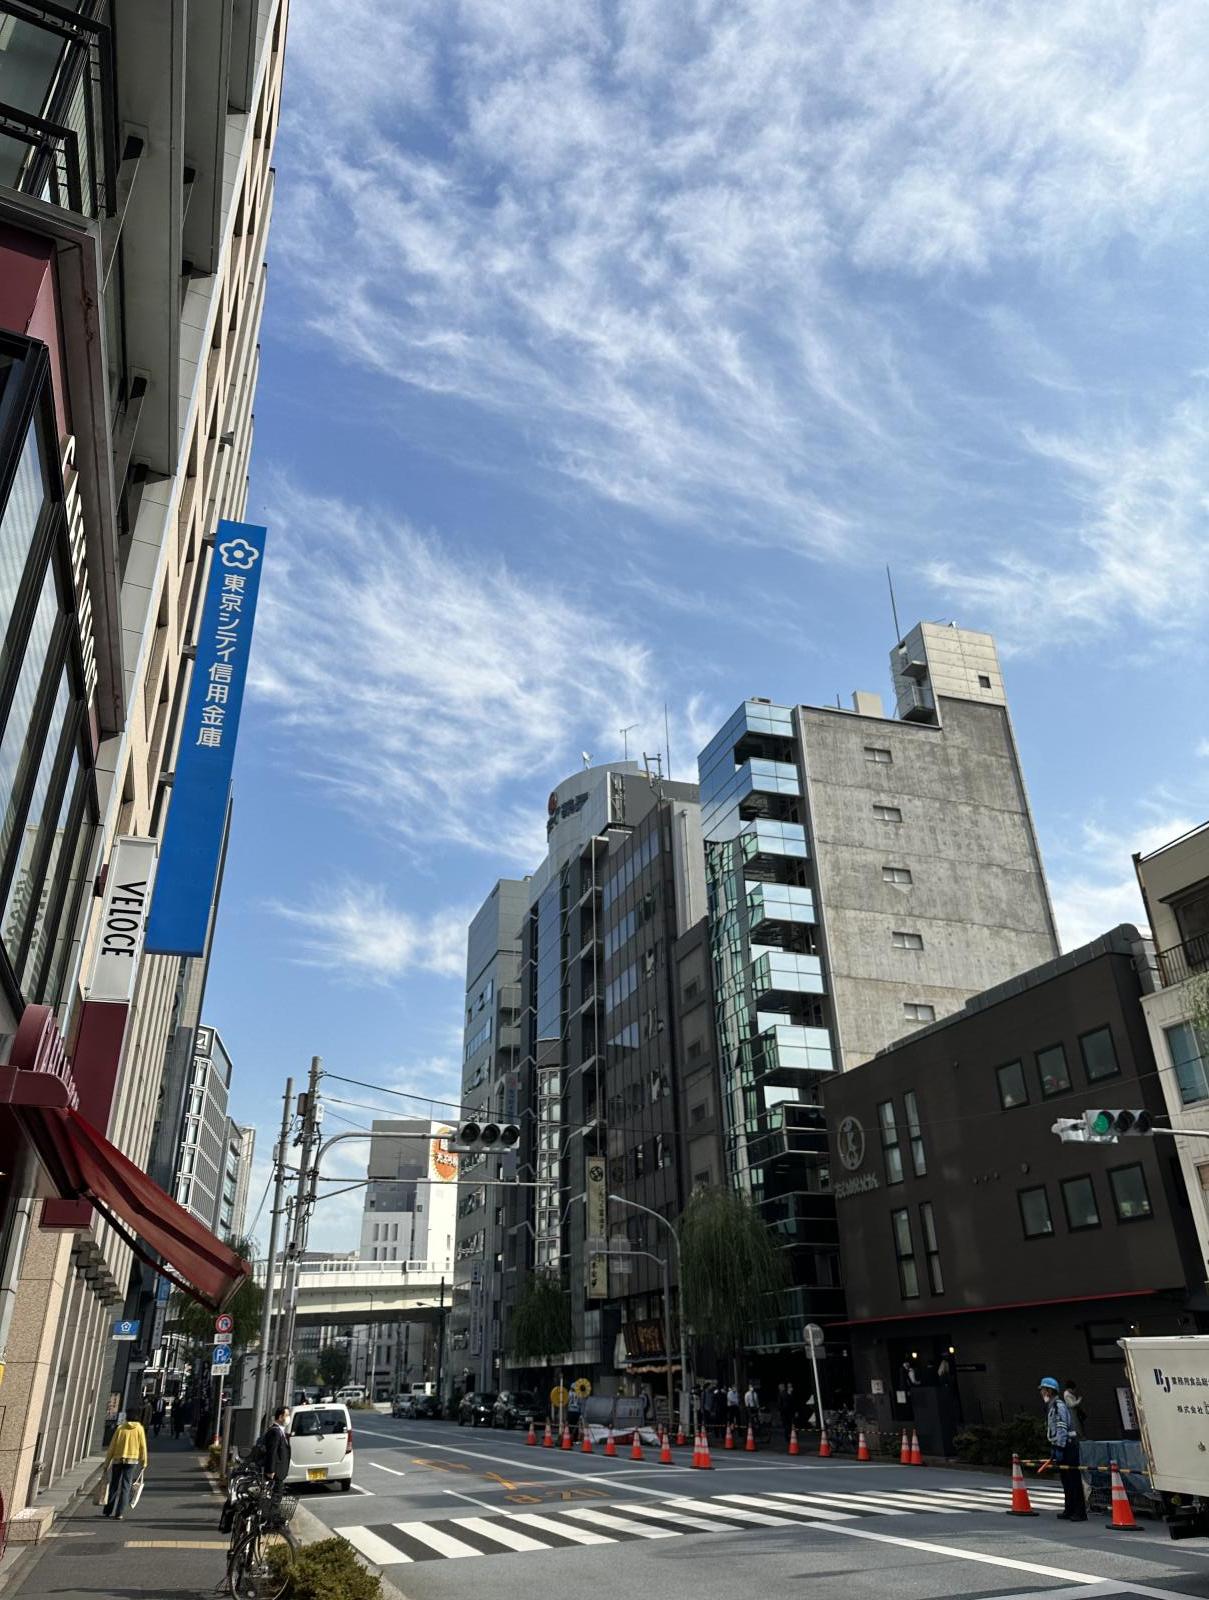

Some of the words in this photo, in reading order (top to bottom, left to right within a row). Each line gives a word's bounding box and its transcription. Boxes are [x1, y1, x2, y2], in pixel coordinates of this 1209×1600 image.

[196, 573, 247, 748] 東京シティ信用金庫
[101, 881, 147, 957] VELOCE
[216, 1349, 225, 1361] P
[1171, 1376, 1209, 1386] 業務用食品総
